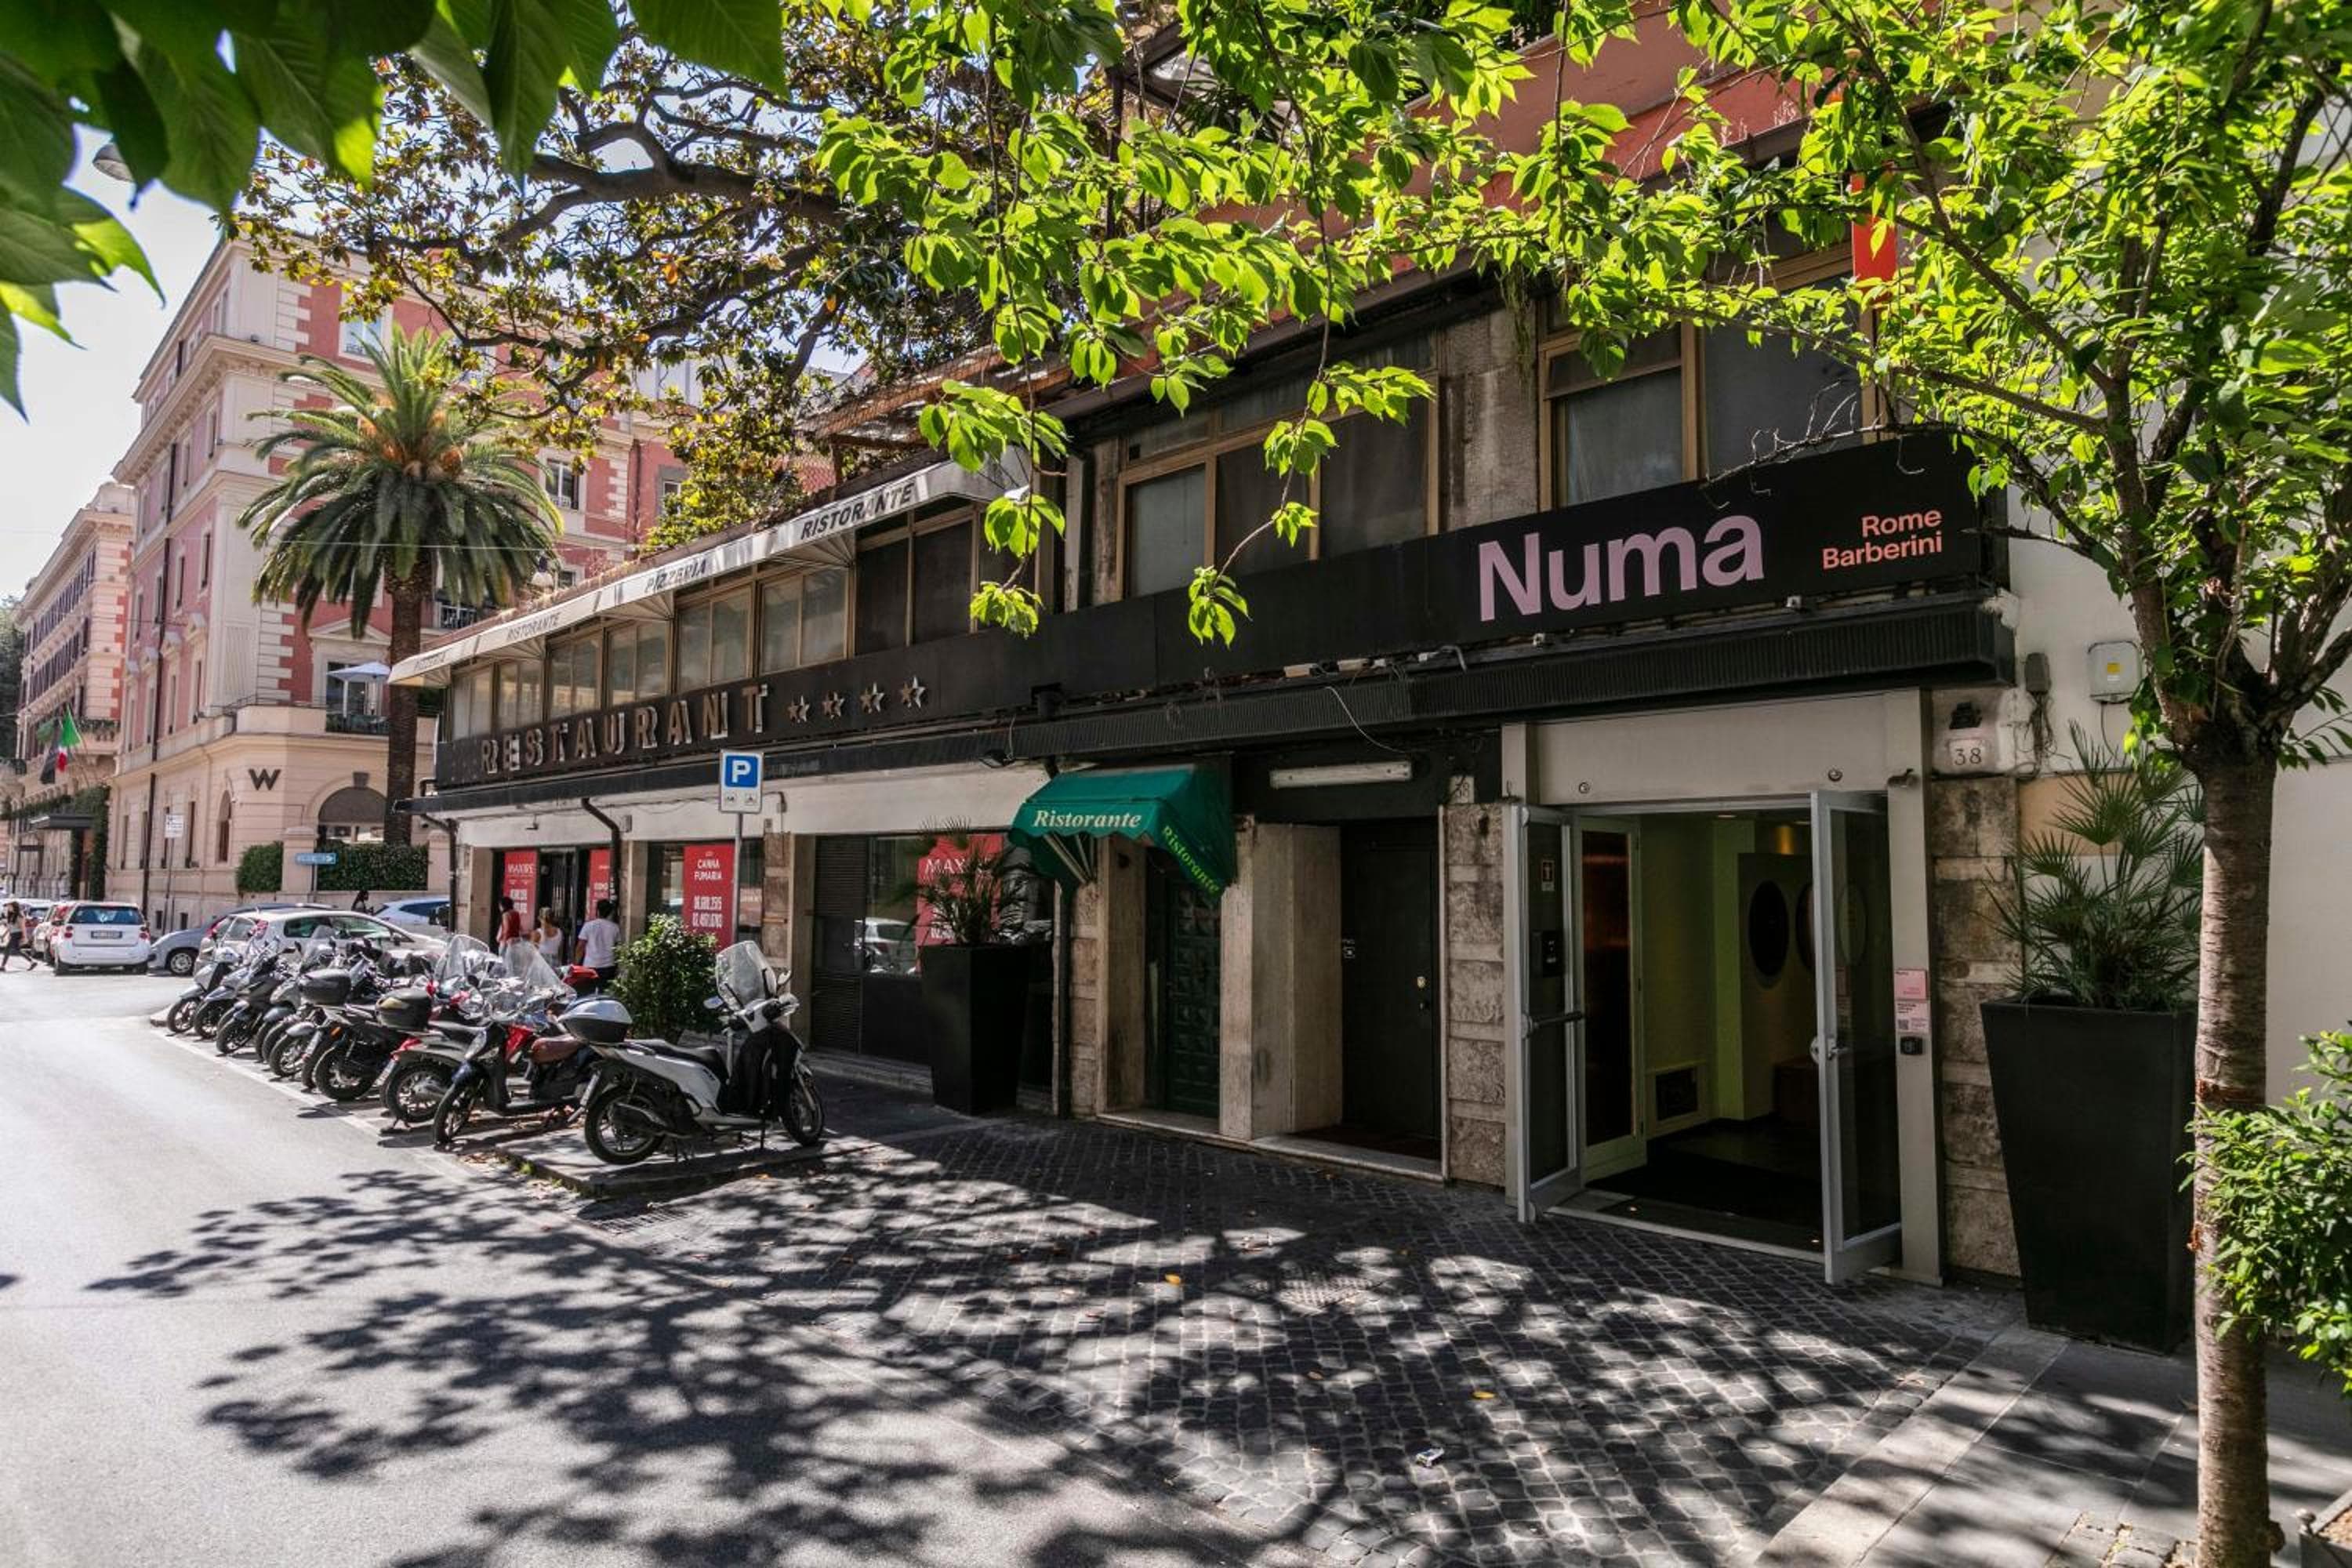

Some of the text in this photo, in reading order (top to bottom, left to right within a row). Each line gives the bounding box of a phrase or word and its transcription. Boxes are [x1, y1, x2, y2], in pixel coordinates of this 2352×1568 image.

[800, 482, 916, 540] RISTORANTE
[1861, 508, 1943, 539] Rome
[1478, 514, 1765, 622] Numa
[1823, 533, 1943, 570] Barberini
[481, 684, 768, 775] RESTAURANT
[731, 760, 752, 783] P
[1955, 747, 1982, 765] 38
[248, 768, 281, 791] W
[1032, 810, 1142, 829] Ristorante
[1162, 825, 1221, 893] Ristorante
